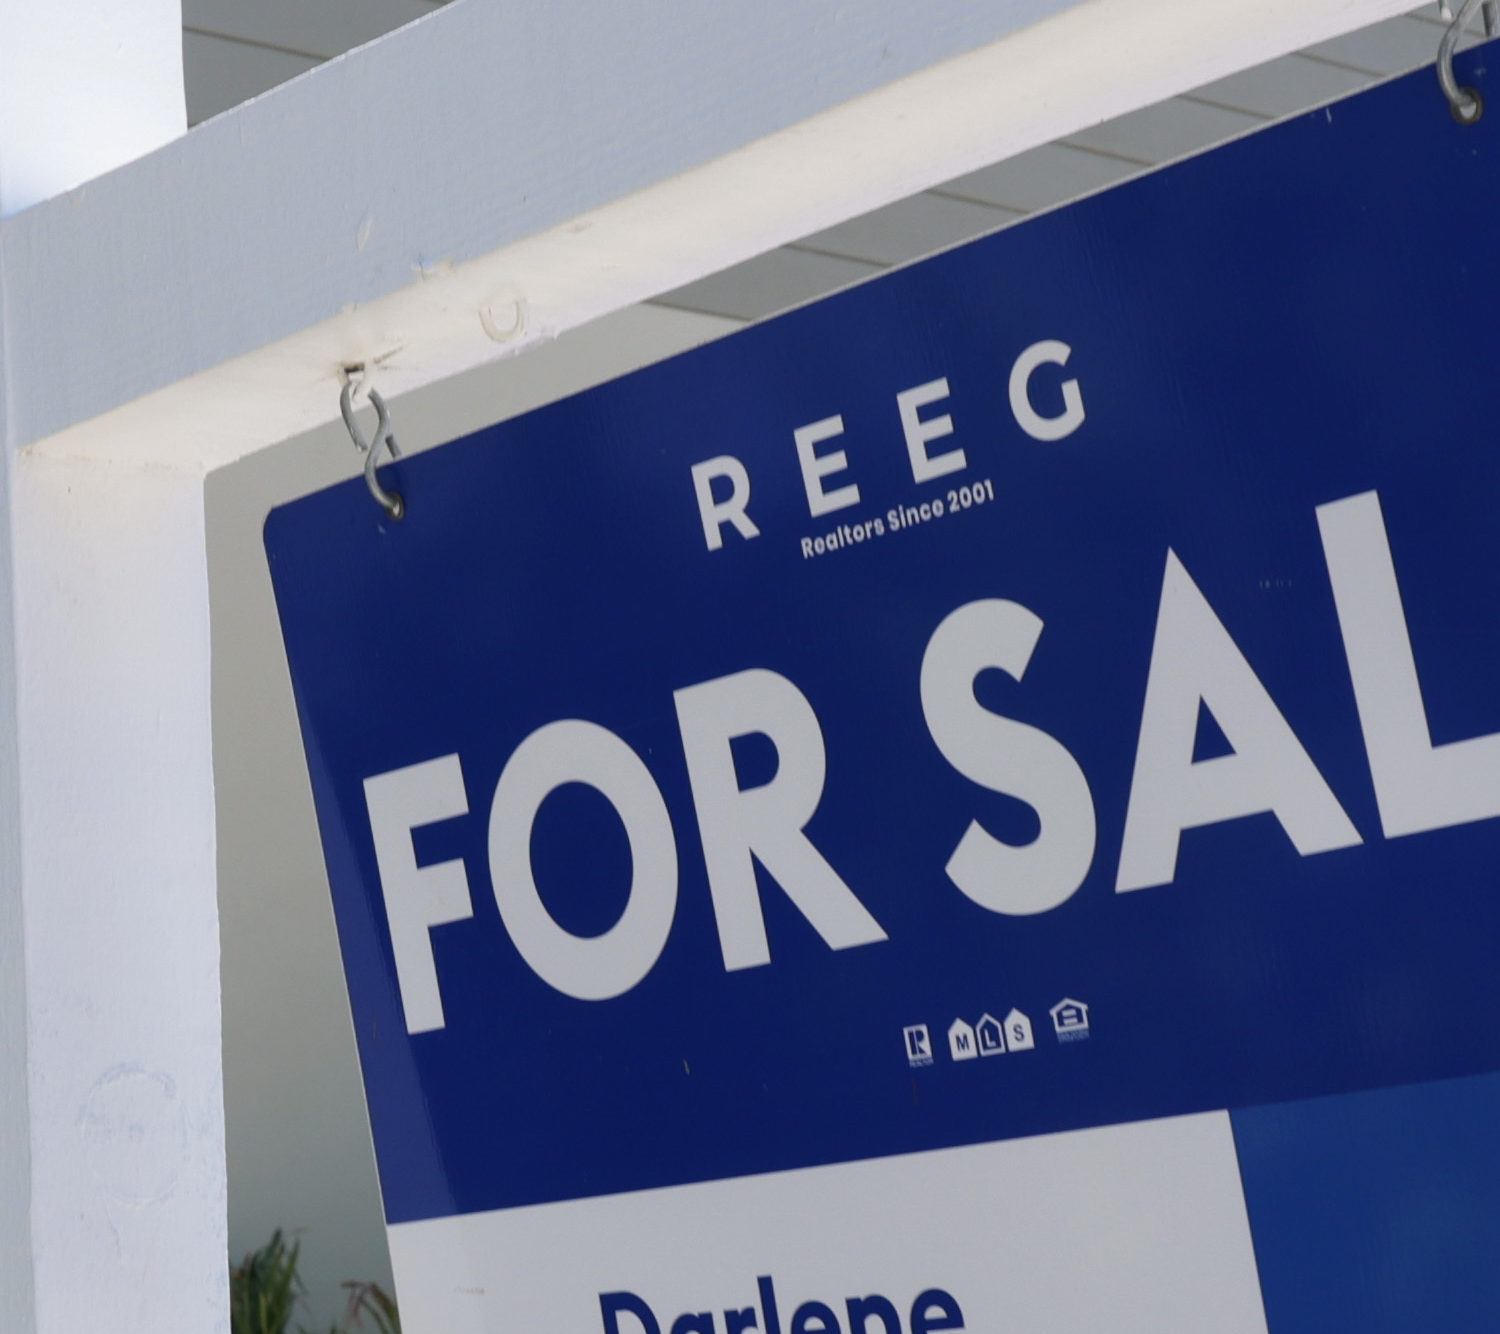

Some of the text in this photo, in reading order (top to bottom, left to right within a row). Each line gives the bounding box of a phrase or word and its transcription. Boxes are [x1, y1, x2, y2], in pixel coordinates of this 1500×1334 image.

[690, 339, 1086, 552] REEG
[800, 478, 995, 559] Realtors Since 2001
[362, 668, 889, 1035] FOR
